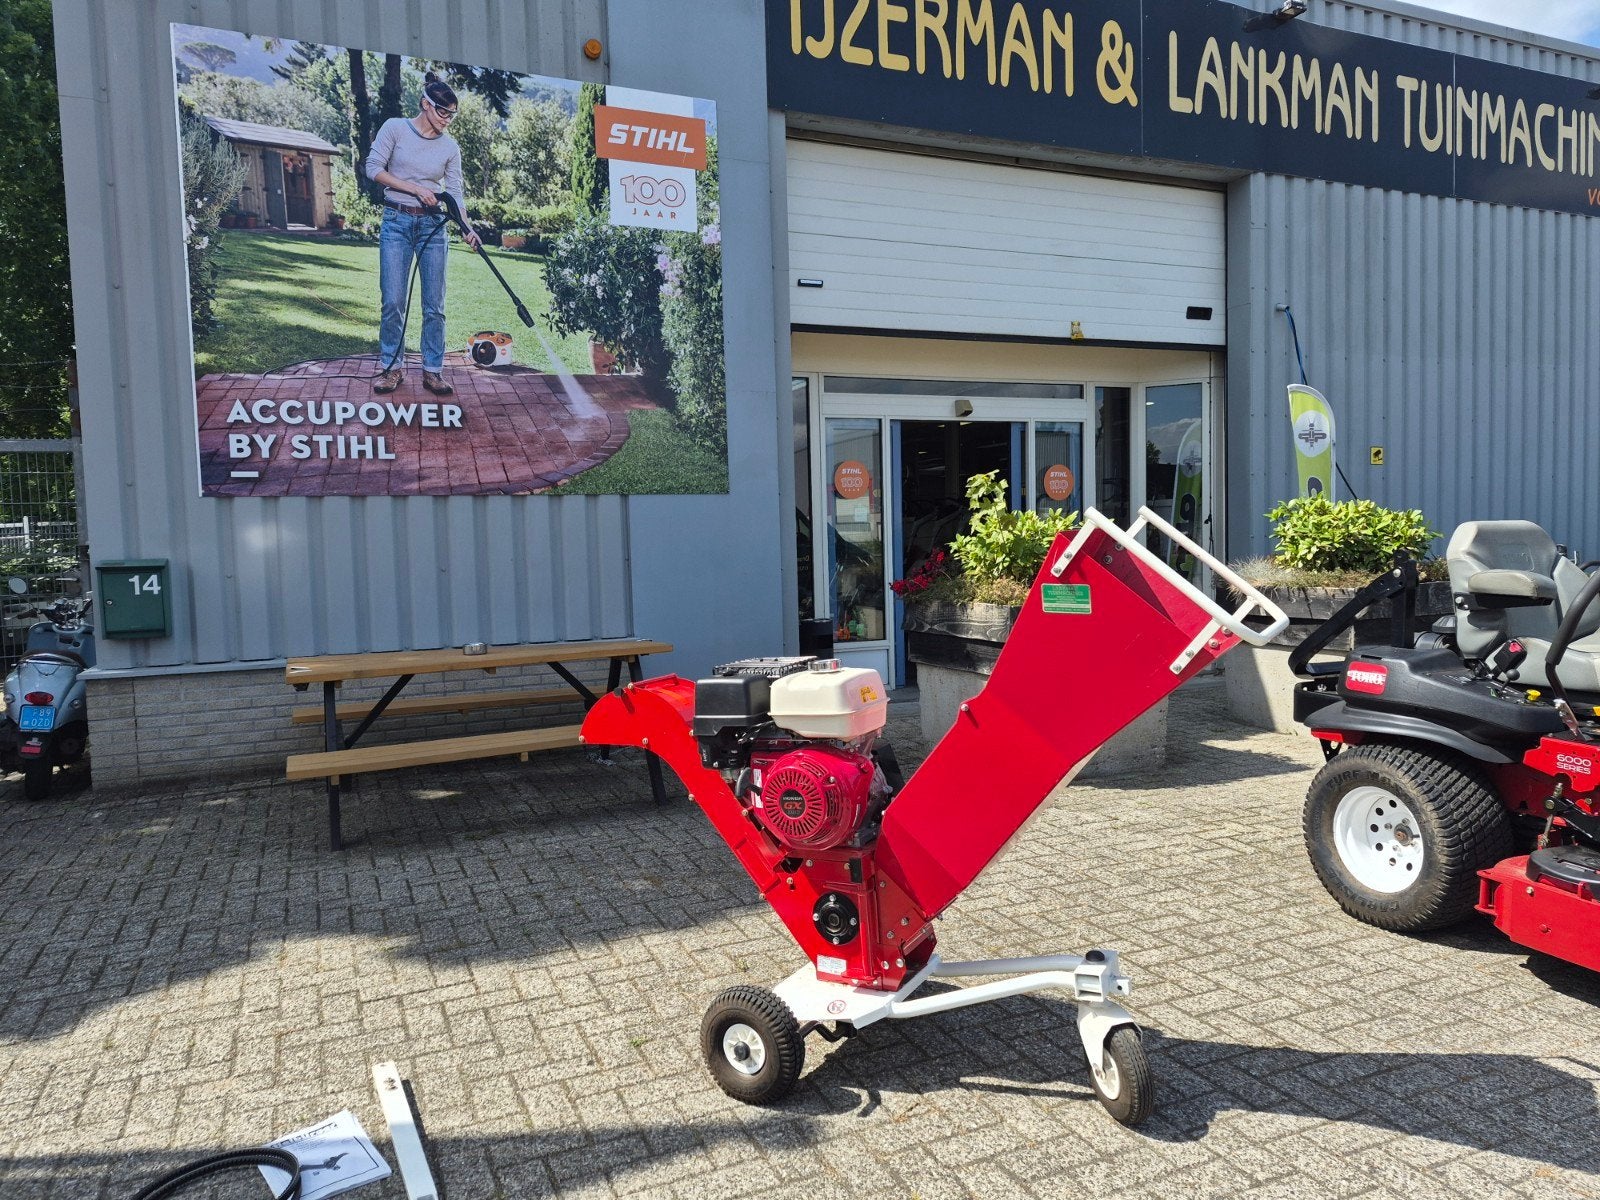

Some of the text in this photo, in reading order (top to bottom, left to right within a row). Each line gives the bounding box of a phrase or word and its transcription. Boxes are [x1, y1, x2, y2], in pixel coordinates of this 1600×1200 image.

[790, 0, 1073, 97] IJZERMAN
[1096, 20, 1138, 107] &
[1168, 30, 1379, 143] LANKMAN
[607, 123, 695, 154] STIHL
[620, 175, 687, 208] 100
[632, 208, 676, 219] JAAR
[226, 398, 462, 428] ACCUPOWER
[229, 433, 396, 460] BY STIHL
[840, 477, 863, 488] 100
[129, 574, 161, 596] 14
[1556, 754, 1592, 767] 6000
[1556, 762, 1591, 775] SERIES
[783, 801, 802, 810] GX
